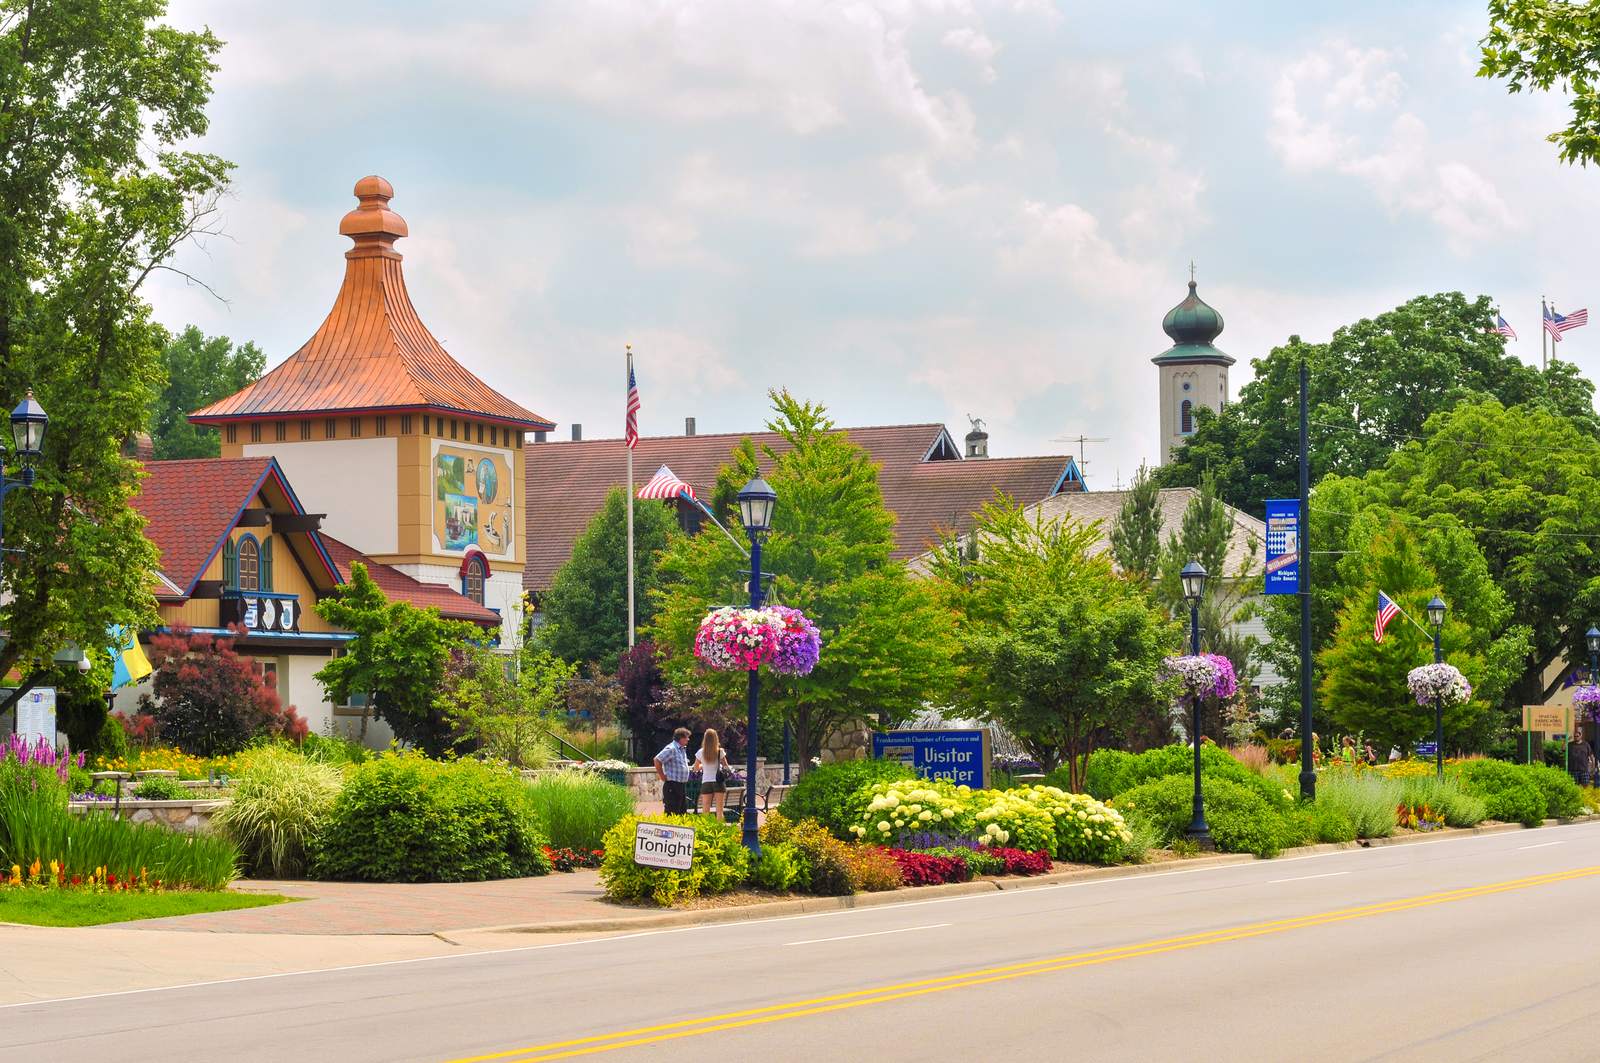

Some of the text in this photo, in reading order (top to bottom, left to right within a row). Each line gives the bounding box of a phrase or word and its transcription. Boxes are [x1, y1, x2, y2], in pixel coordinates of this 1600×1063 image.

[924, 748, 972, 762] Visitor
[924, 766, 974, 782] Center
[638, 827, 655, 836] Friday
[676, 832, 693, 840] Nights
[638, 837, 692, 858] Tonight
[636, 856, 668, 864] Downtown
